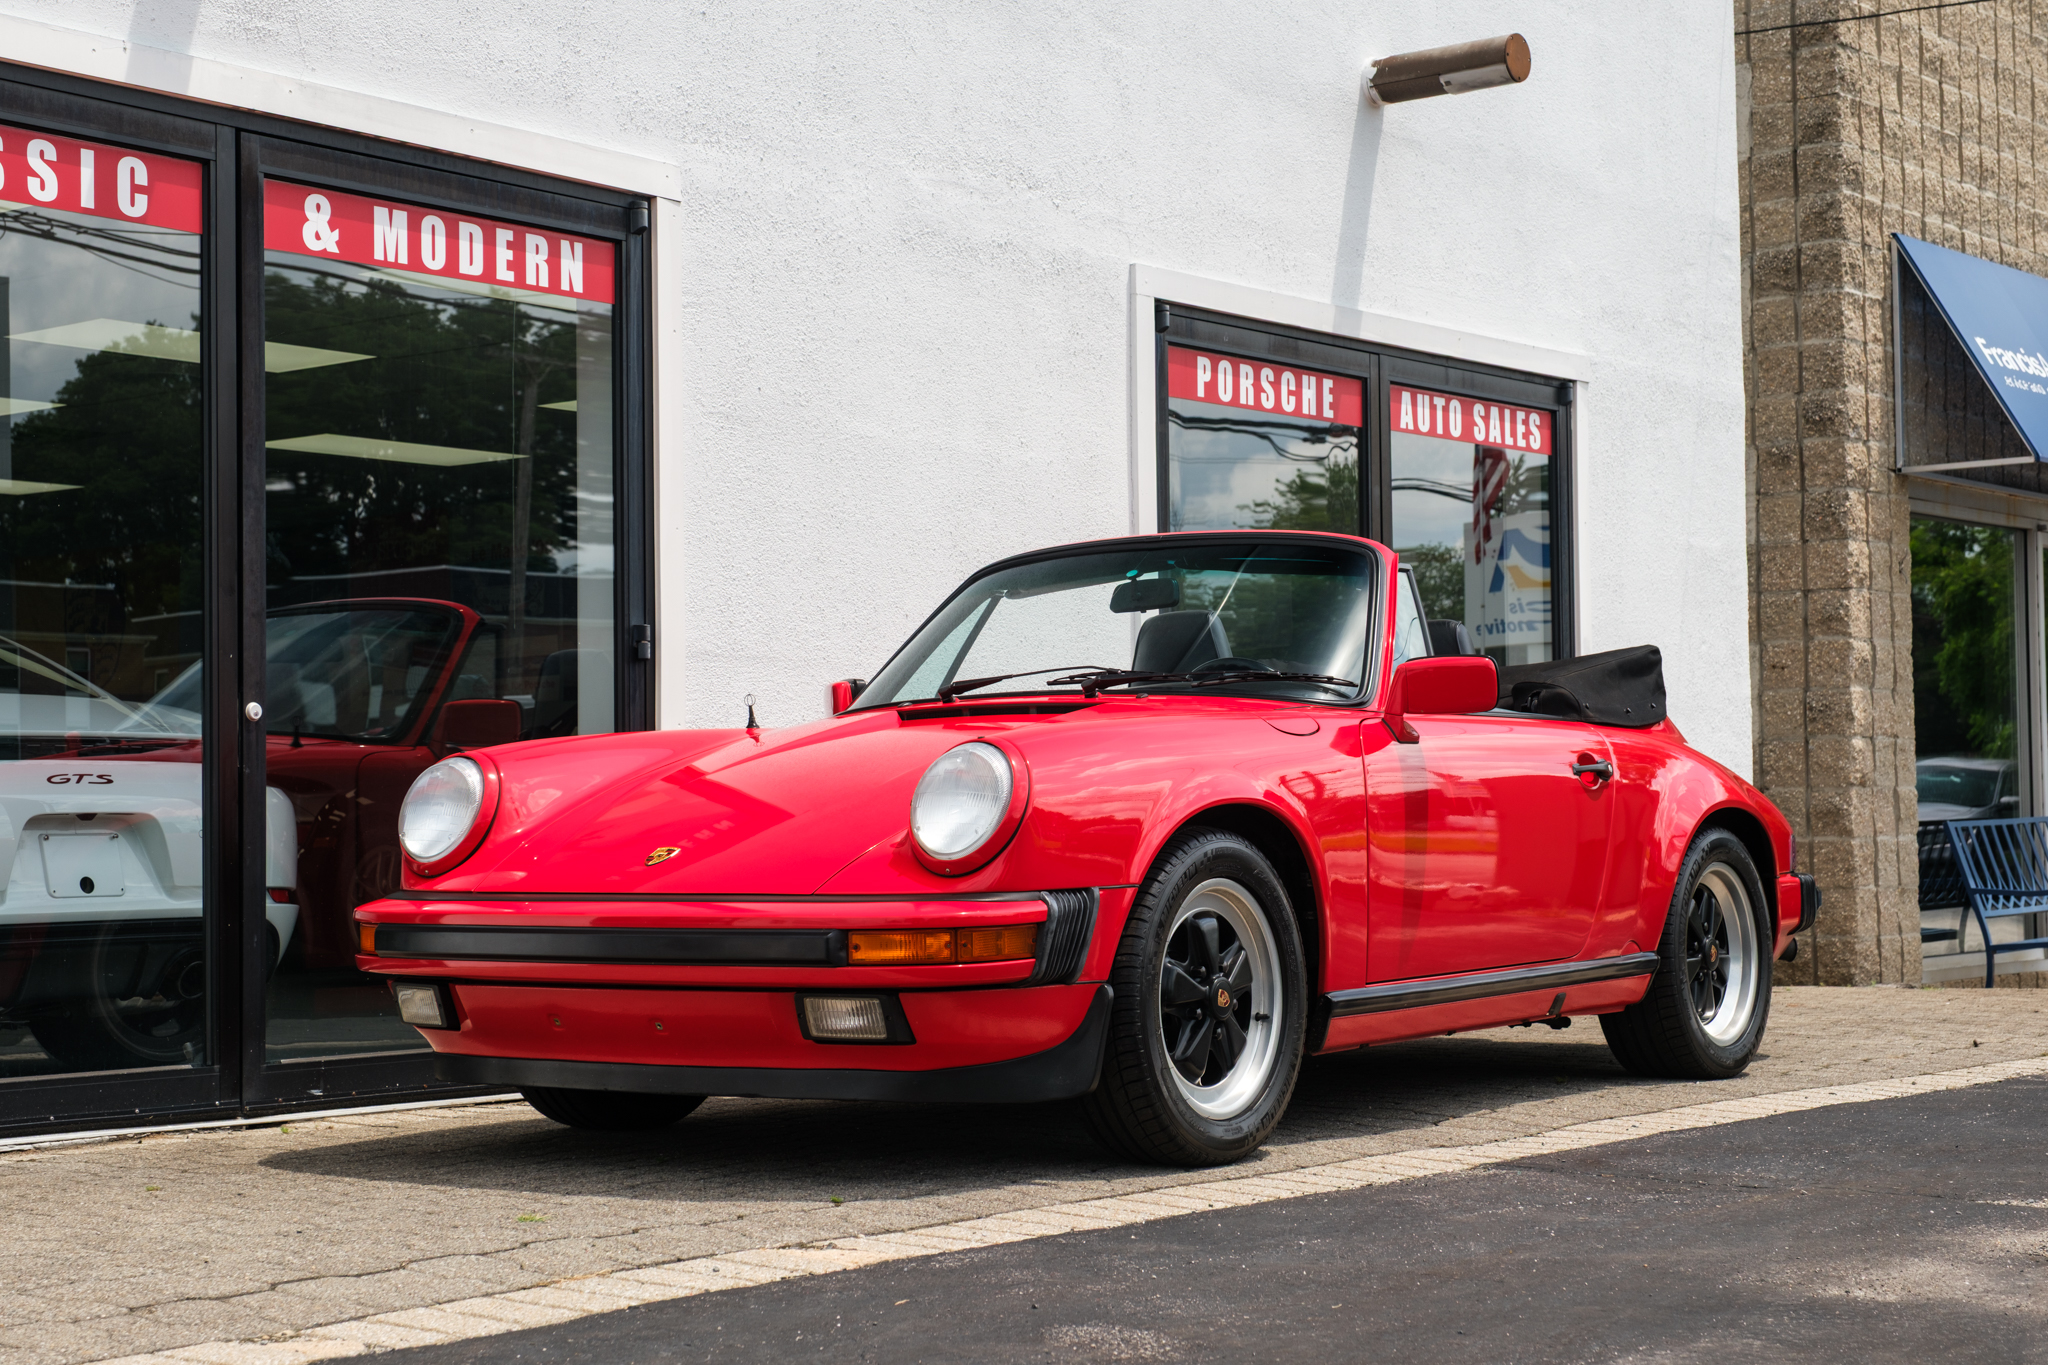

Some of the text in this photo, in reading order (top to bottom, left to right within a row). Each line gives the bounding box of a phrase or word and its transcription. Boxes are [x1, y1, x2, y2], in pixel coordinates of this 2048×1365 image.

[0, 136, 149, 218] SIC
[302, 194, 584, 293] & MODERN
[1197, 355, 1334, 418] PORSCHE
[1400, 391, 1541, 450] AUTO SALES
[46, 773, 114, 785] GTS
